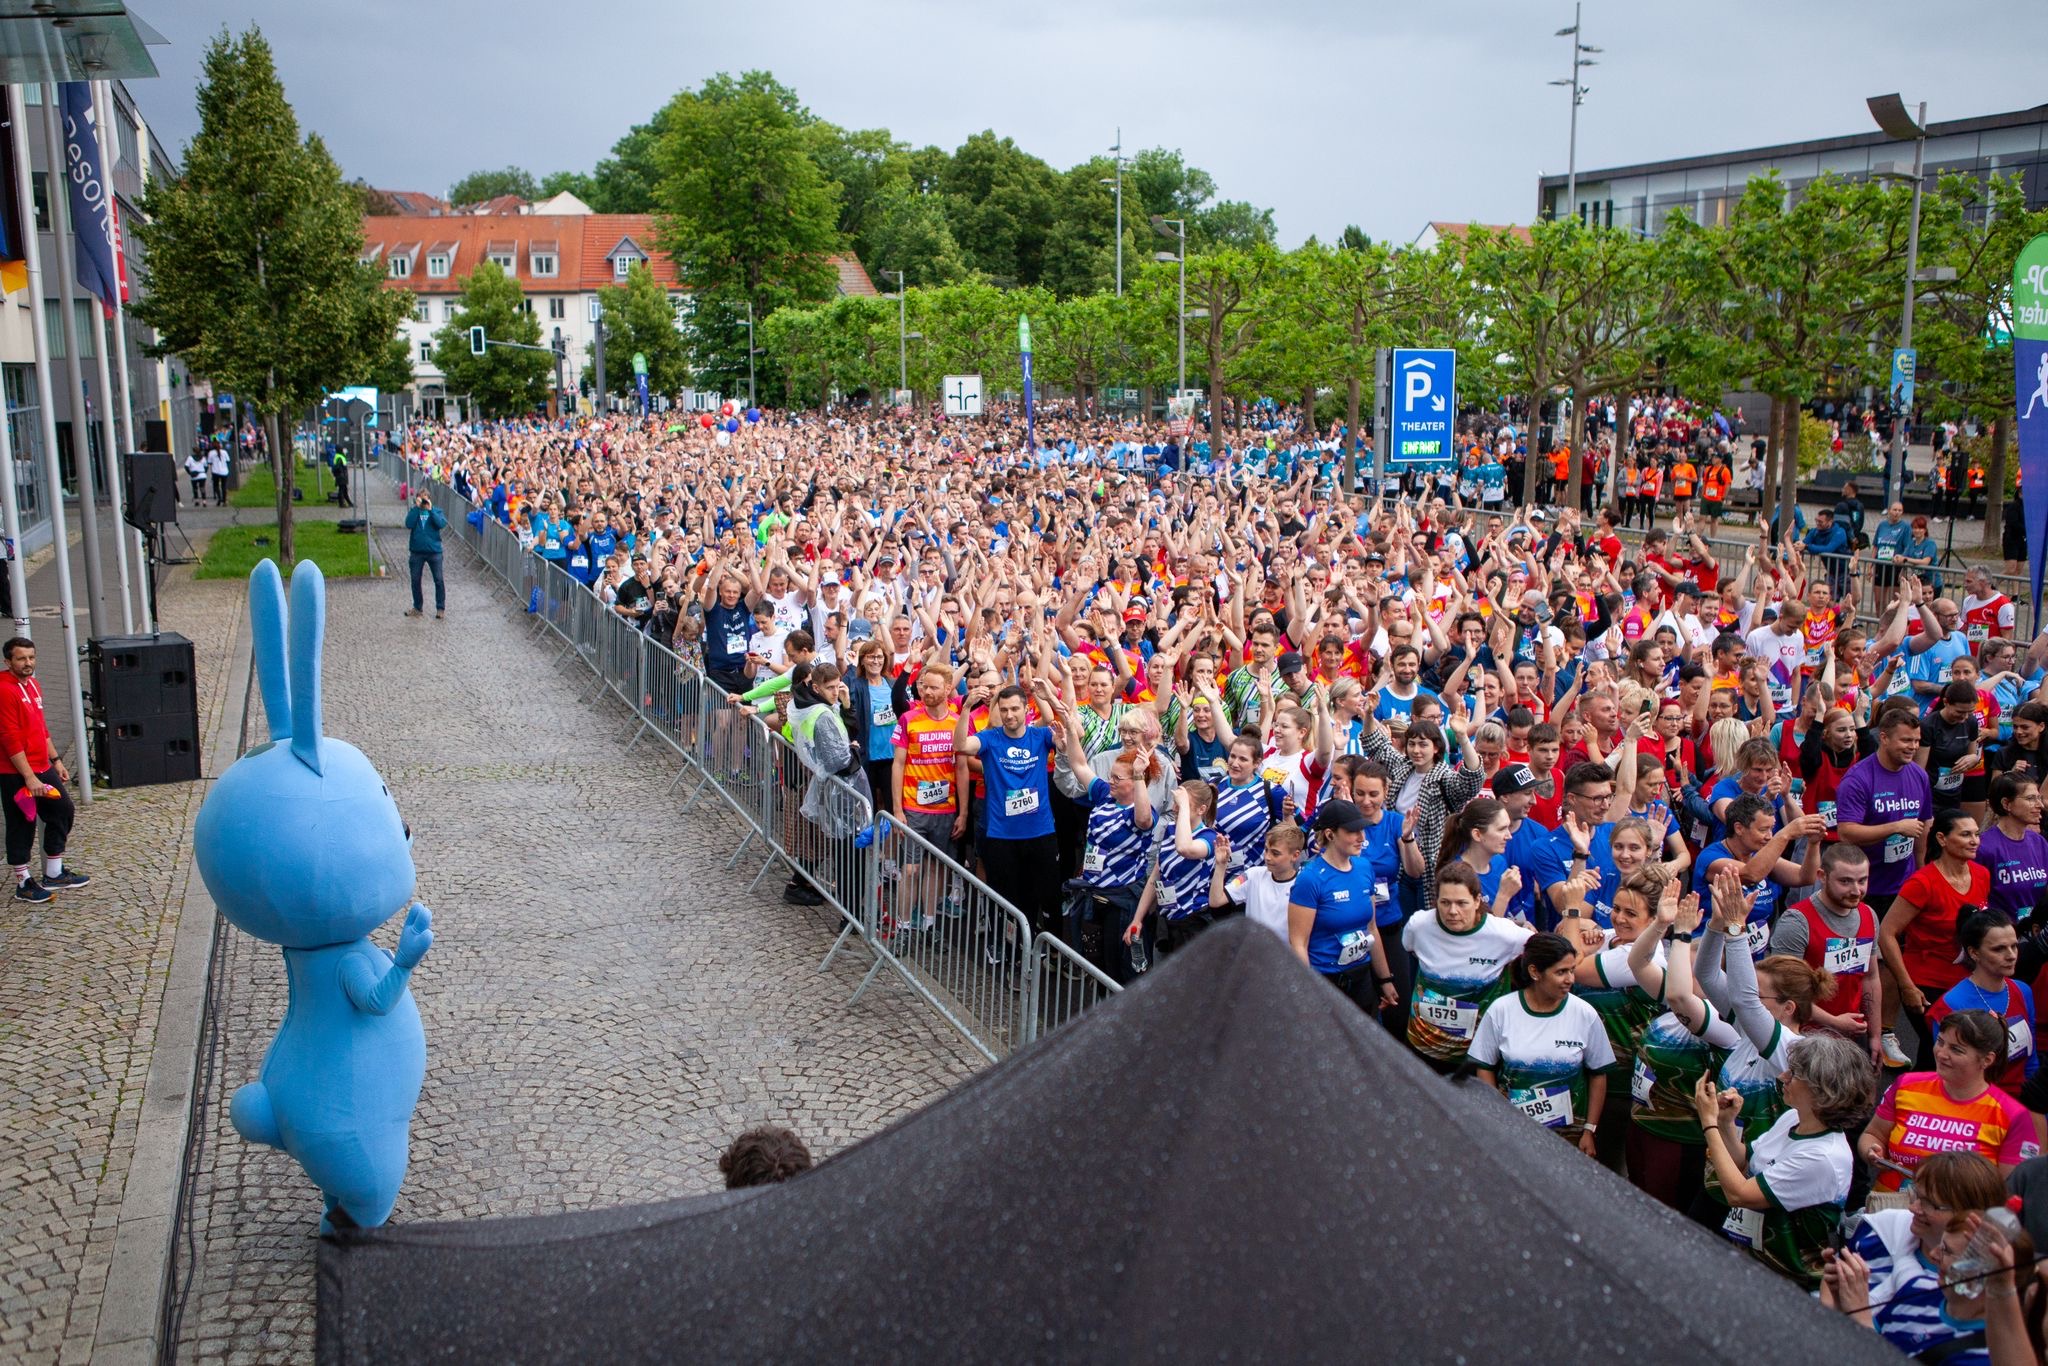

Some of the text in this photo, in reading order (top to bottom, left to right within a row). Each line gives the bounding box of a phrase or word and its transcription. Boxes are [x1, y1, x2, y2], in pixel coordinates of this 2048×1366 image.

[1405, 371, 1432, 411] P
[1401, 421, 1445, 431] THEATER
[1401, 440, 1441, 455] EINFAHRT
[1780, 646, 1795, 656] CG
[919, 731, 951, 742] BILDUNG
[922, 743, 954, 753] BEWEGT
[922, 787, 943, 800] 3445
[1012, 795, 1033, 810] 2760
[1886, 798, 1921, 813] Helios
[1825, 808, 1838, 822] 16
[2012, 866, 2047, 883] Helios
[1834, 947, 1859, 965] 1674
[1427, 1006, 1458, 1021] 1579
[1906, 1114, 1975, 1137] BILDUNG
[1903, 1132, 1976, 1153] BEWEGT
